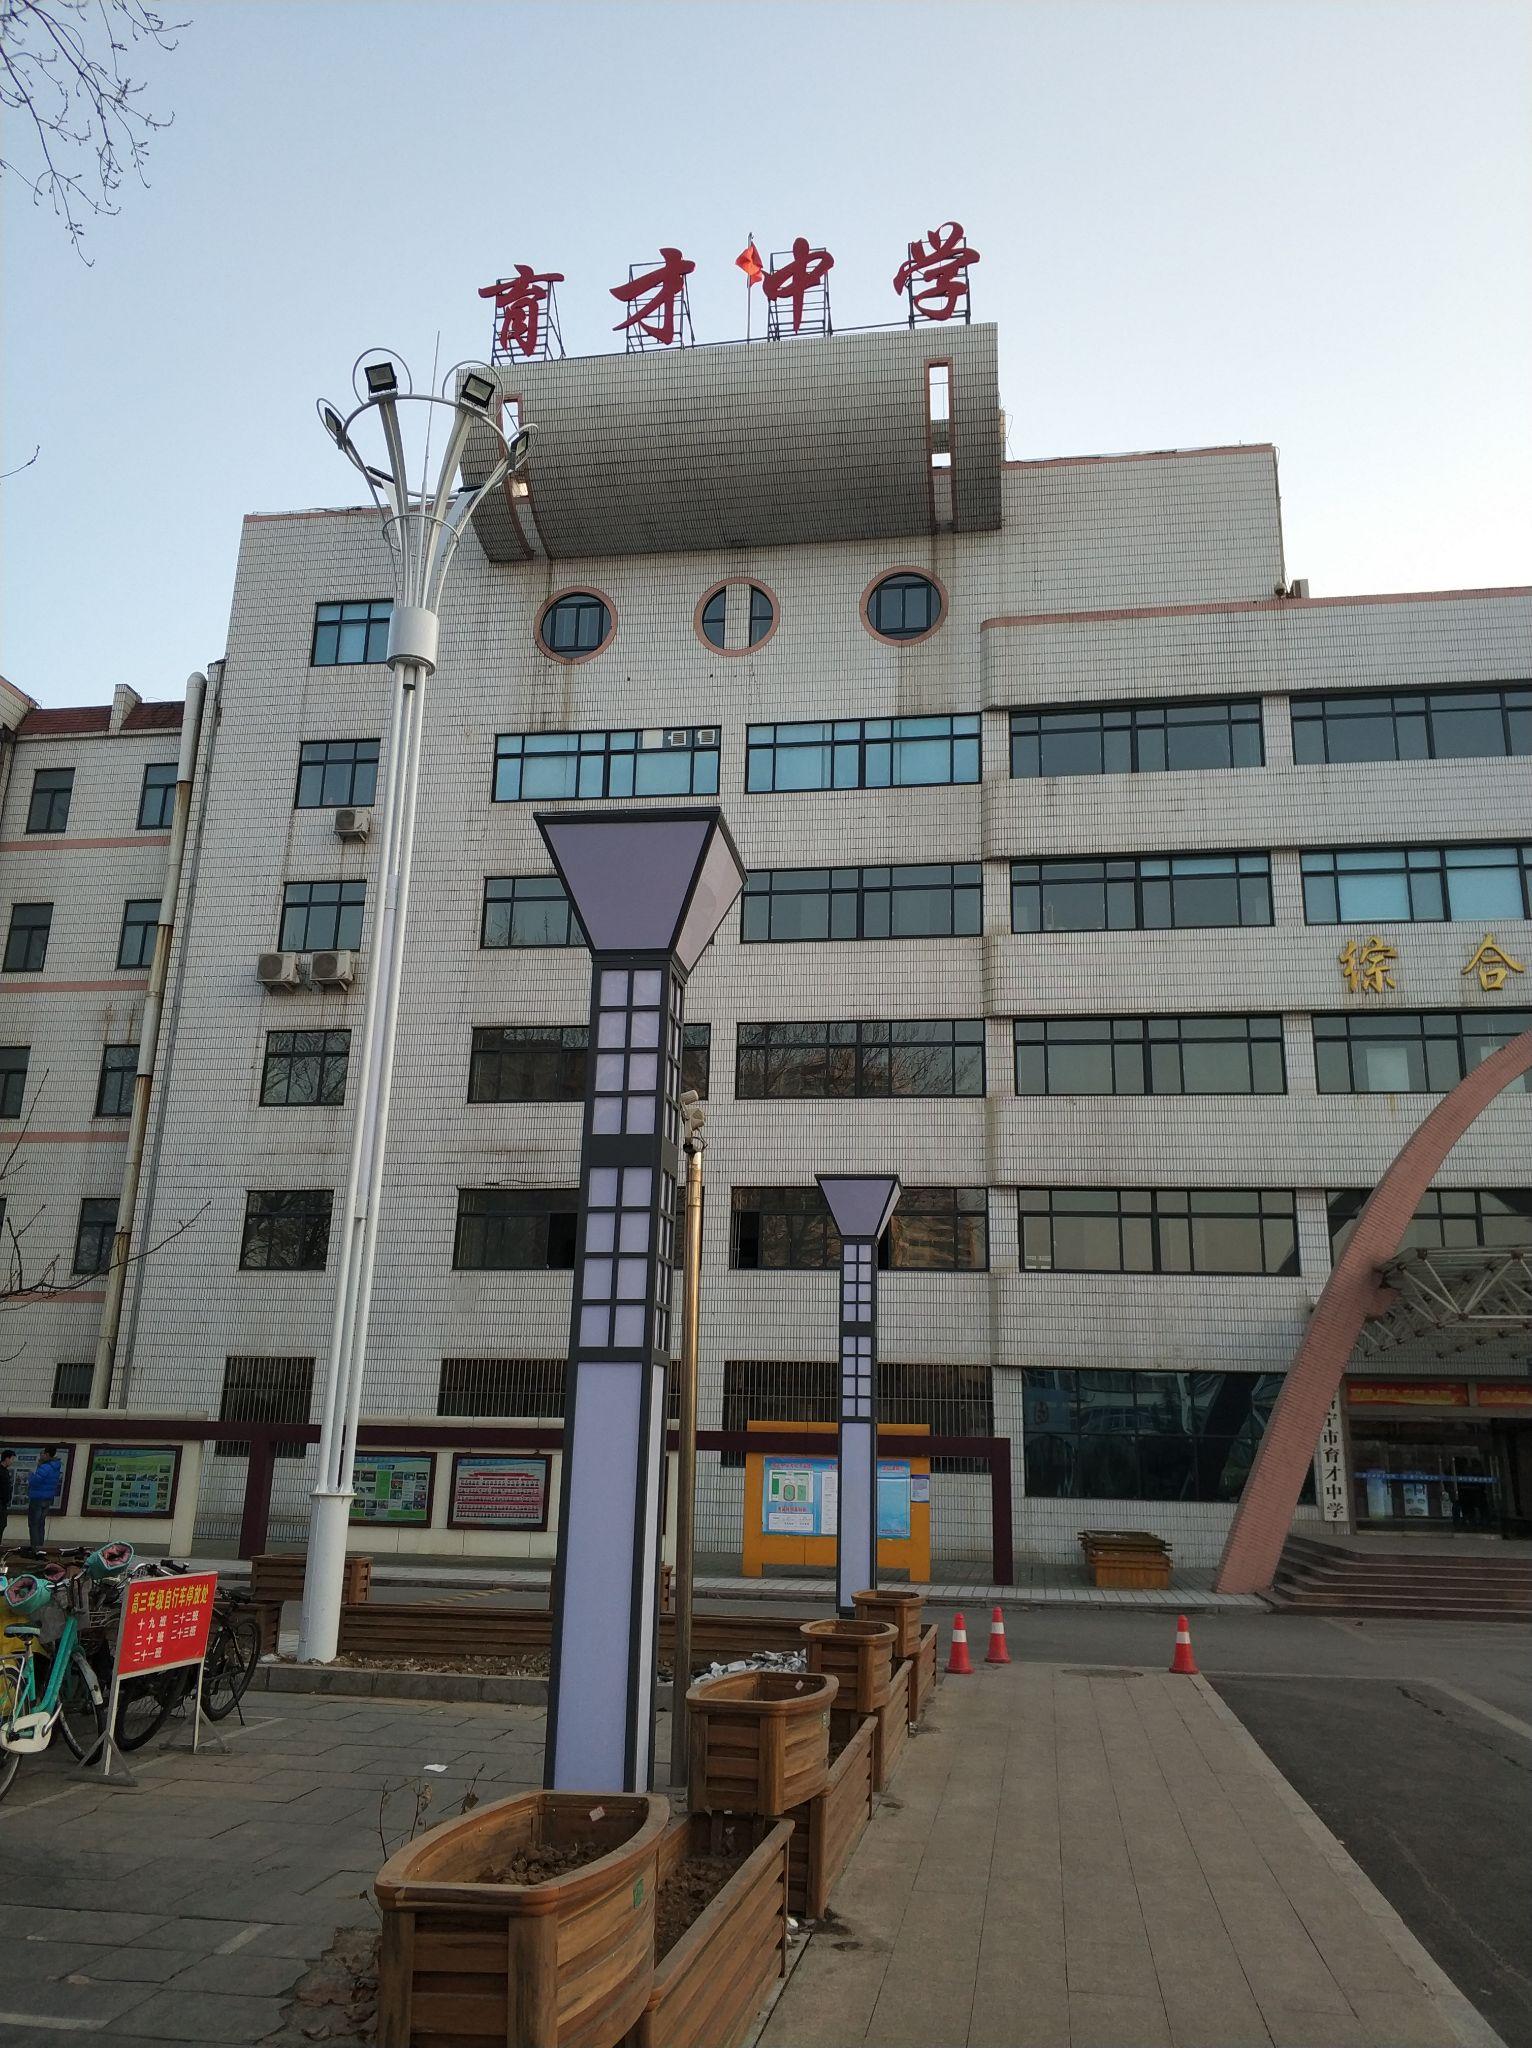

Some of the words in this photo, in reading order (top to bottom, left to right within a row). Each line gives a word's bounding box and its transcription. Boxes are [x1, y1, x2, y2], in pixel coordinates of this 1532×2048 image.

[477, 221, 980, 357] 育才中学
[1339, 932, 1525, 993] 综合
[131, 1584, 208, 1613] 高三年级自行车停放处
[173, 1610, 199, 1624] 二十二班
[171, 1625, 196, 1639] 二十三班
[133, 1647, 162, 1661] 二十一班
